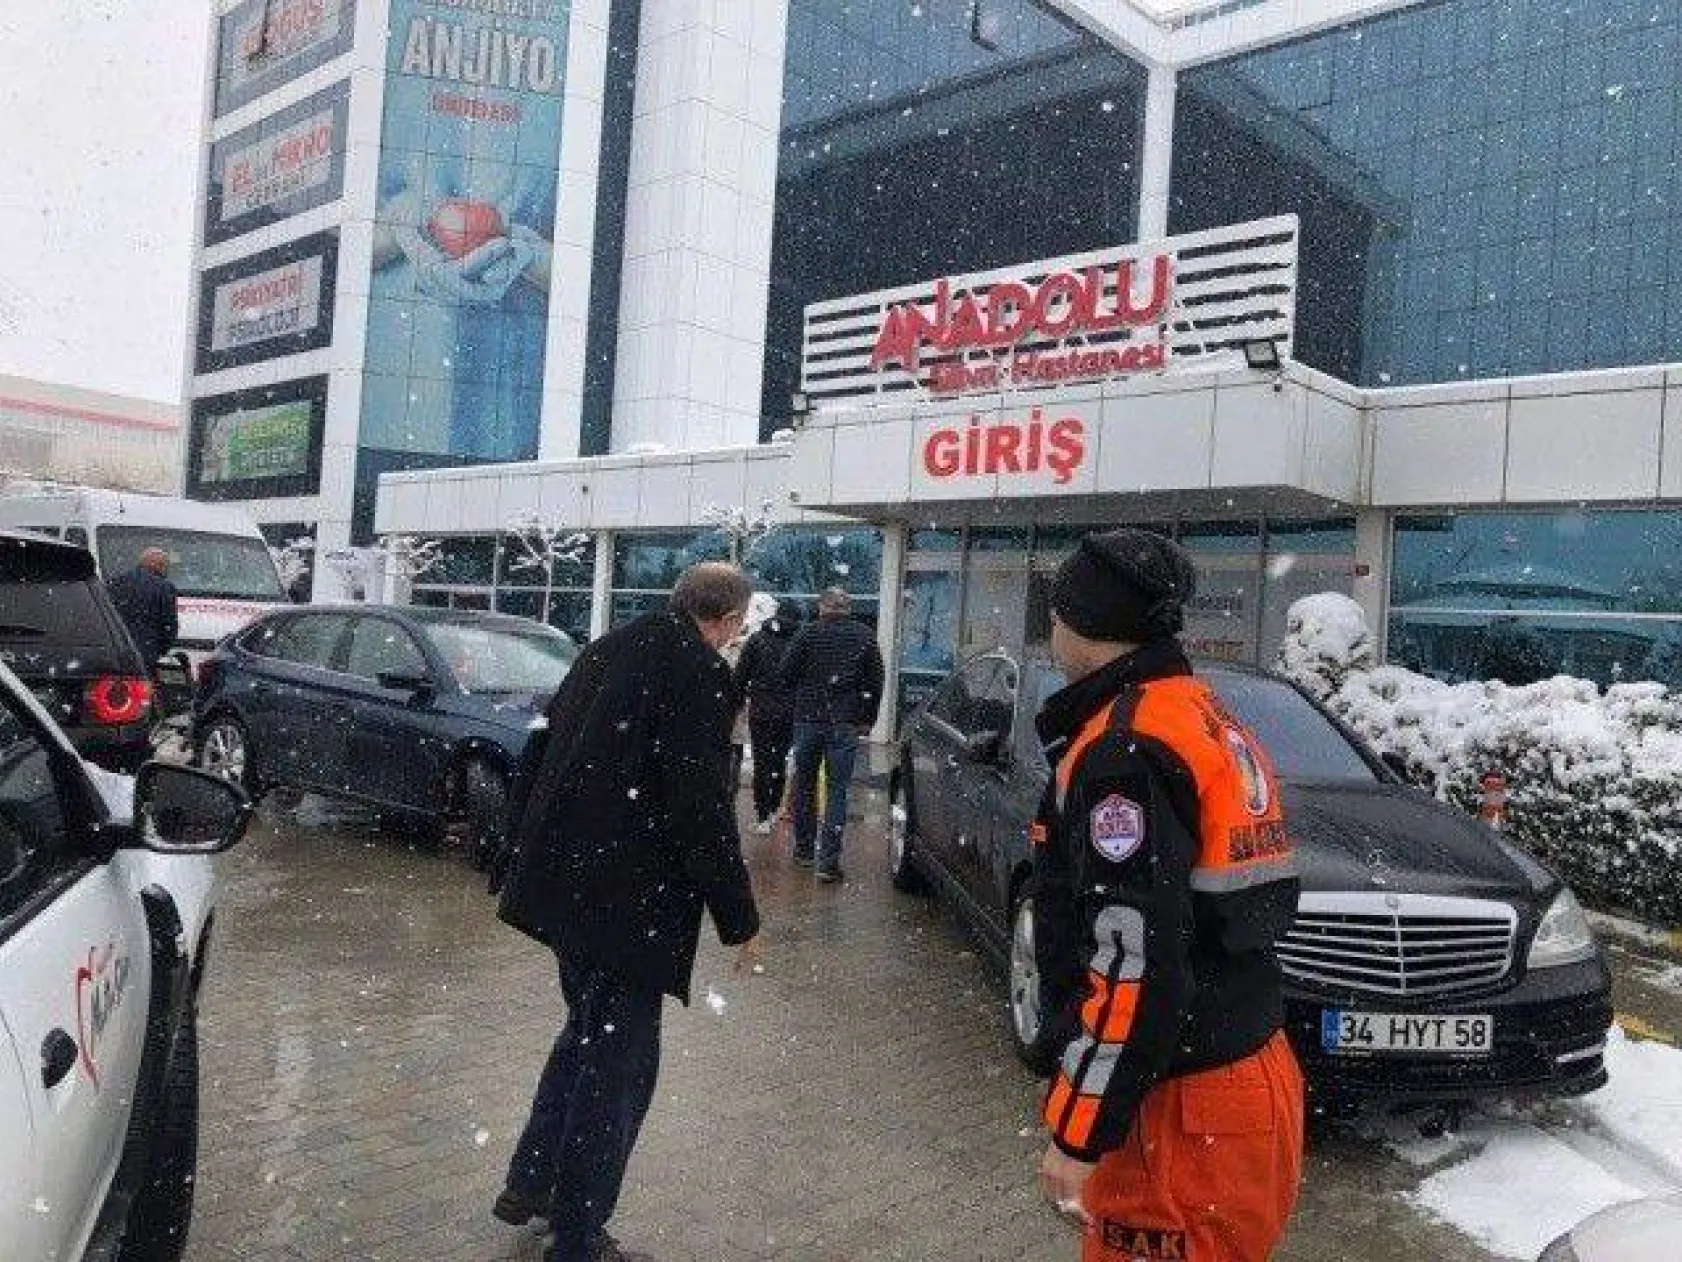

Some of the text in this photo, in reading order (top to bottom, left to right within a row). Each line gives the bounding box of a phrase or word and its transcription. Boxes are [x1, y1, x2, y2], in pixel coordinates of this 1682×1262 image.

[869, 253, 1171, 372] ANADOLU
[923, 406, 1085, 485] GİRİŞ
[1341, 1015, 1486, 1047] 34 HYT 58
